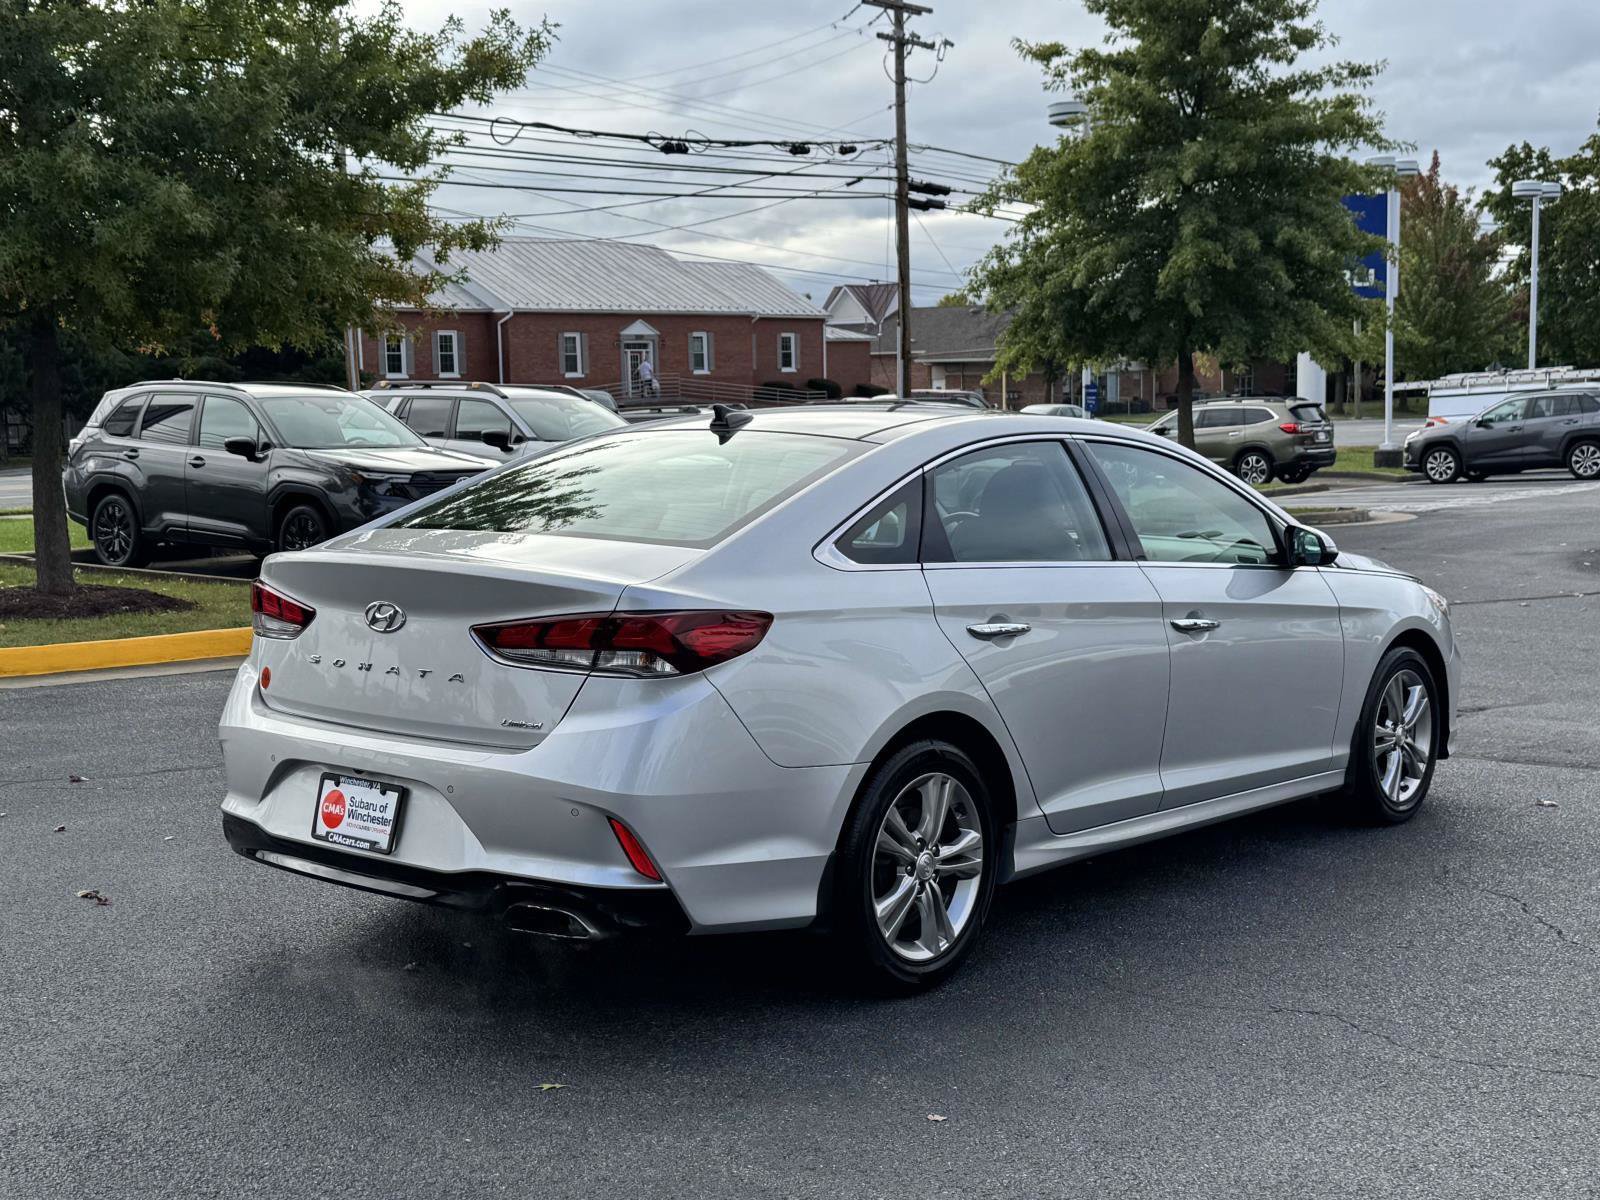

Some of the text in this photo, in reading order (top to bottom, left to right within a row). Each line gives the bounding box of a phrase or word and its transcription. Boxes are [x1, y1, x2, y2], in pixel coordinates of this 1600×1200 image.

[308, 654, 465, 684] SONATA
[323, 803, 345, 816] CMA's
[349, 796, 389, 814] Subaru of
[347, 808, 392, 827] Winchester
[328, 832, 370, 850] CMAcars.com
